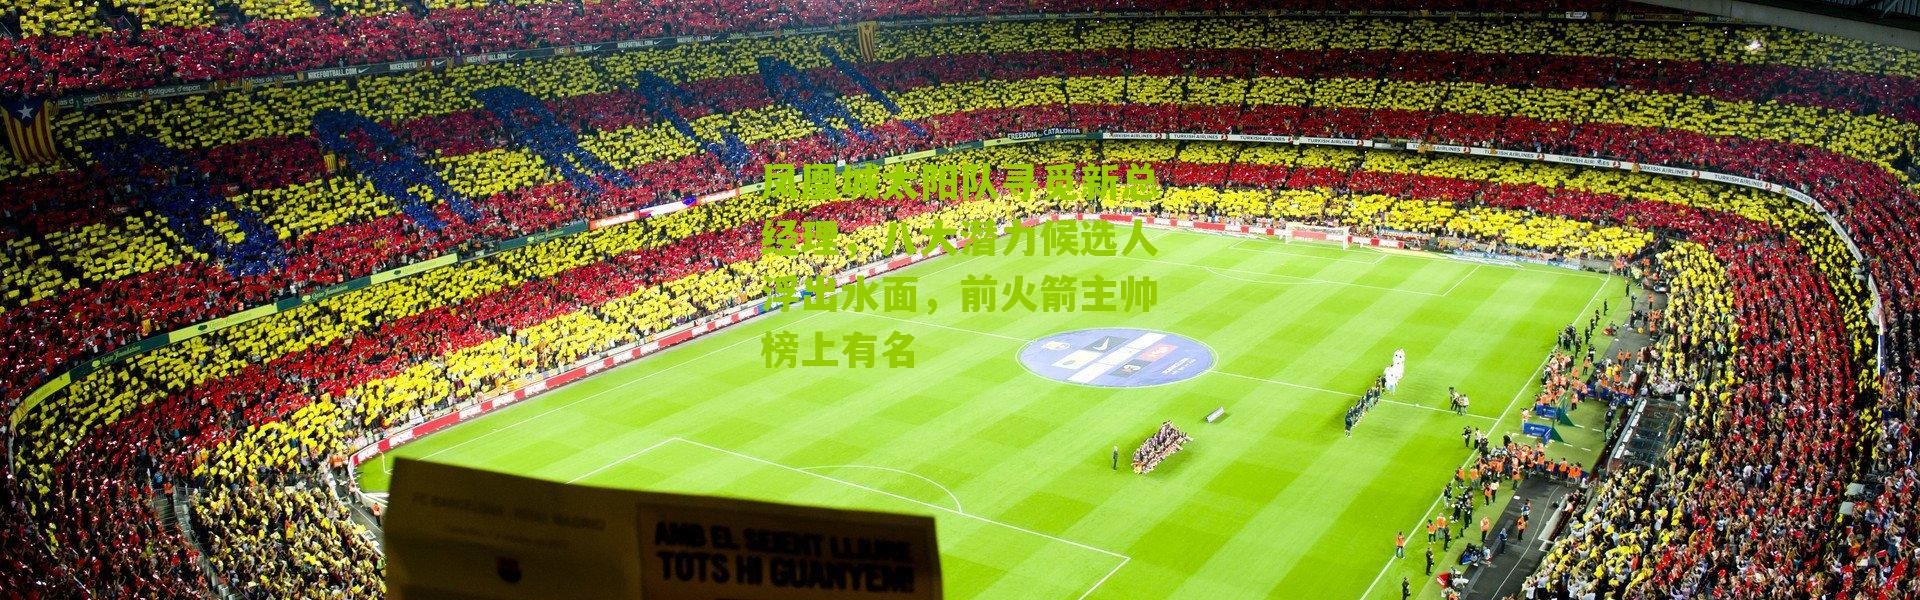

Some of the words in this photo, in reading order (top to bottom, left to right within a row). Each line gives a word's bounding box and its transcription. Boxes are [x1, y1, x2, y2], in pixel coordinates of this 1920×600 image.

[308, 68, 358, 79] NIKEFOOTBALL.COM
[1008, 132, 1038, 140] FREEDOM
[1044, 128, 1080, 136] CATALONIA
[1715, 174, 1740, 182] TURKISH
[1740, 178, 1762, 187] AIRLINES
[655, 520, 706, 548] AMB
[710, 524, 738, 550] EL
[656, 551, 730, 585] TOTS
[735, 555, 763, 586] HI
